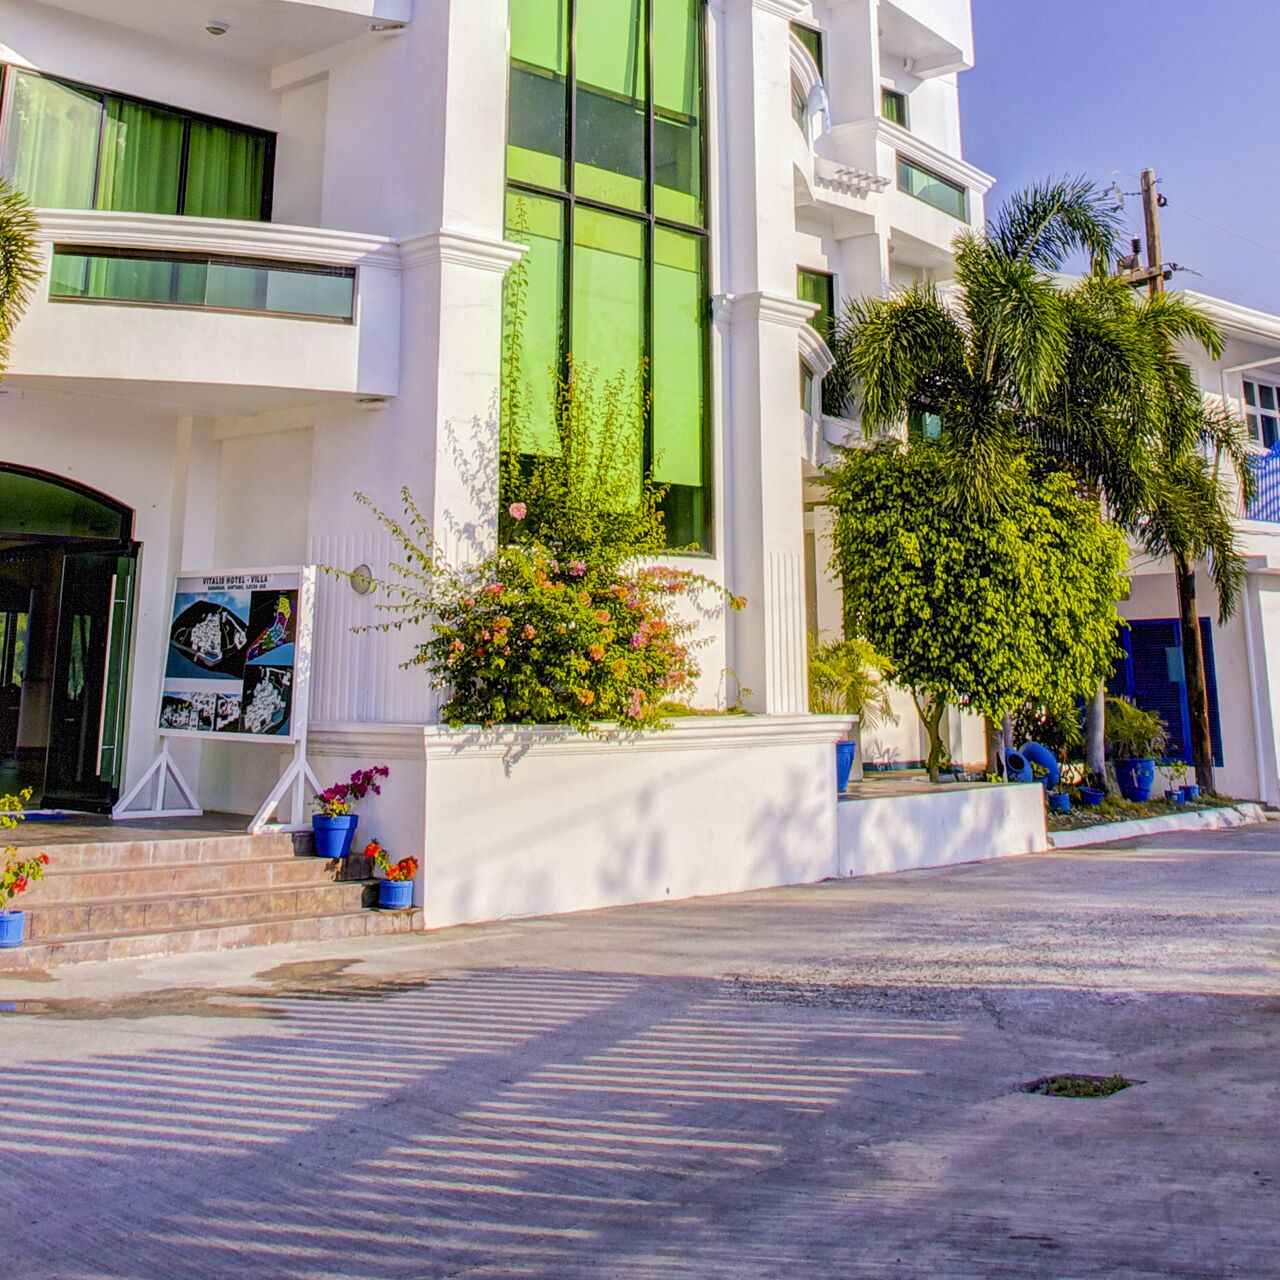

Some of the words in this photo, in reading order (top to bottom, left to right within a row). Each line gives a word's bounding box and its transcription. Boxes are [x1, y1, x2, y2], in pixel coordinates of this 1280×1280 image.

[202, 576, 225, 585] VITALIS
[226, 576, 245, 584] HOTEL
[251, 575, 268, 583] VILLA
